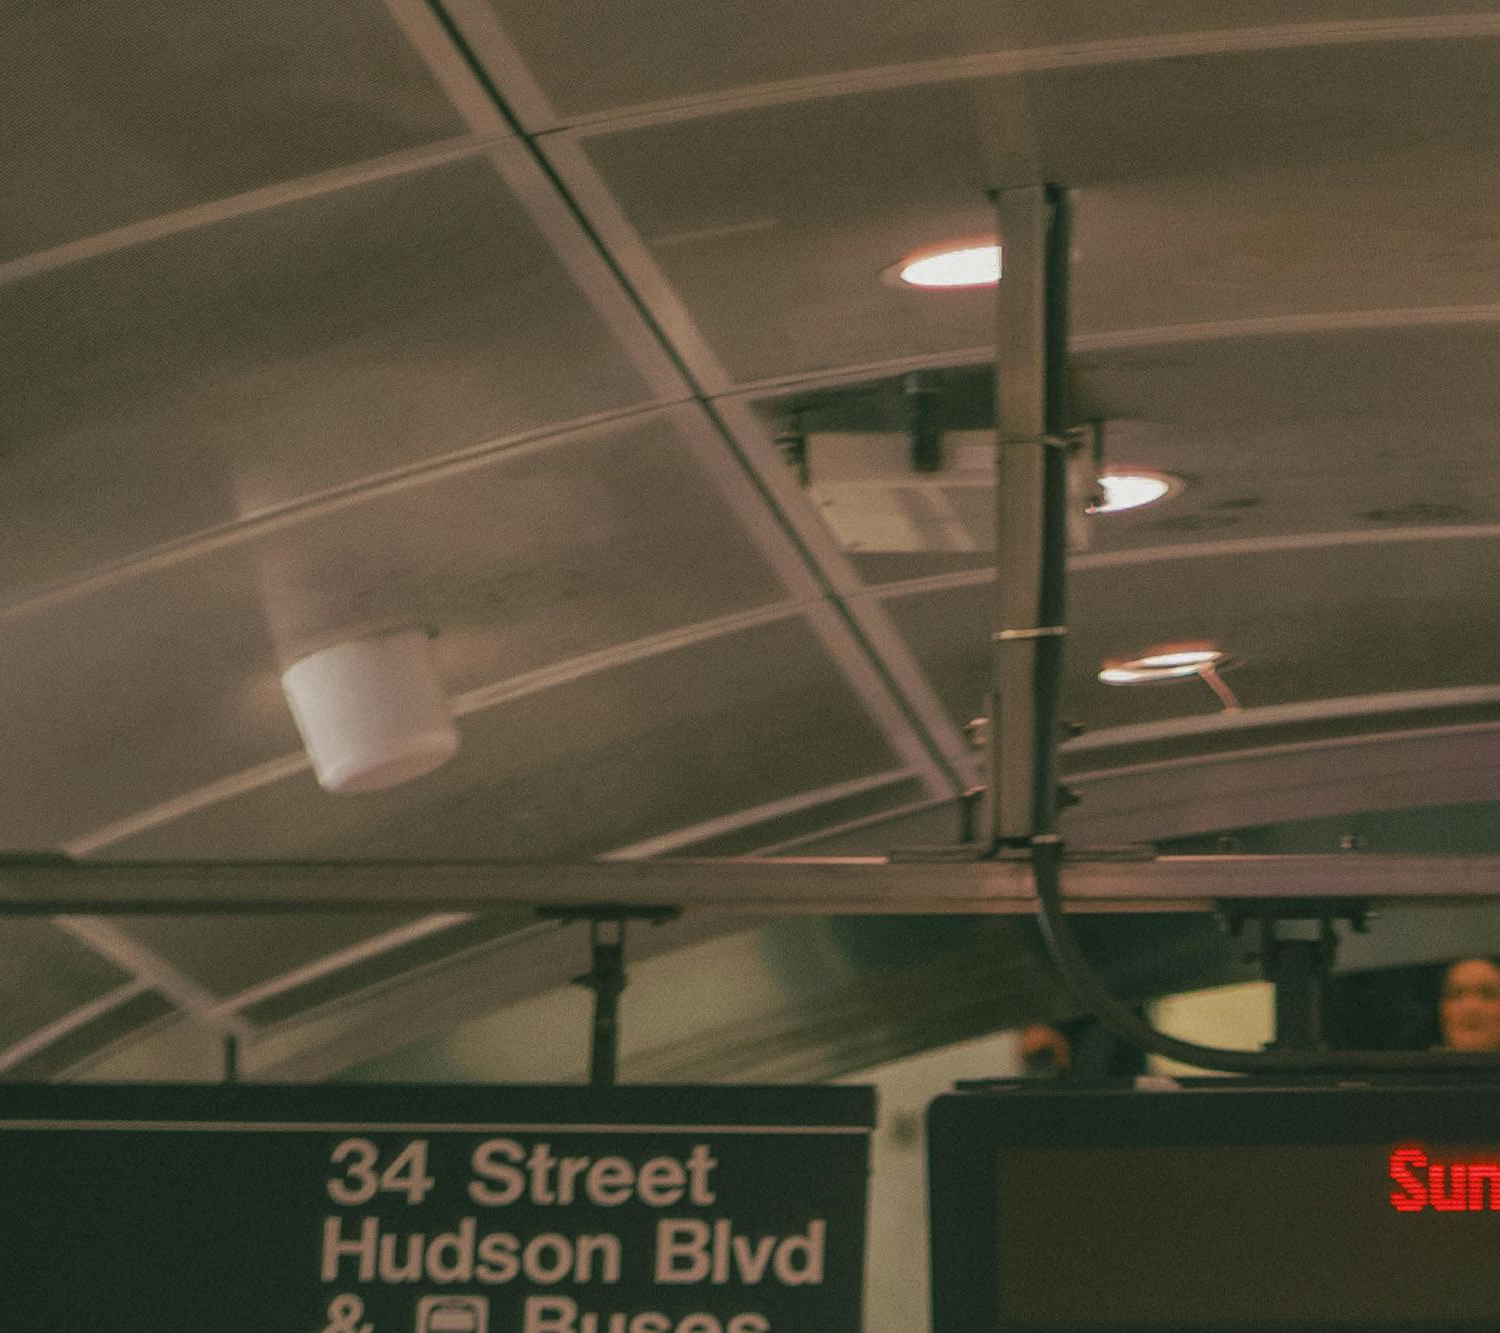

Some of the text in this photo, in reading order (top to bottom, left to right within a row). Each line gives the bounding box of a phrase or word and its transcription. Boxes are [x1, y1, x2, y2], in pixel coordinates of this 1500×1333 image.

[326, 1138, 718, 1206] 34 Street
[321, 1216, 826, 1285] Hudson Blvd
